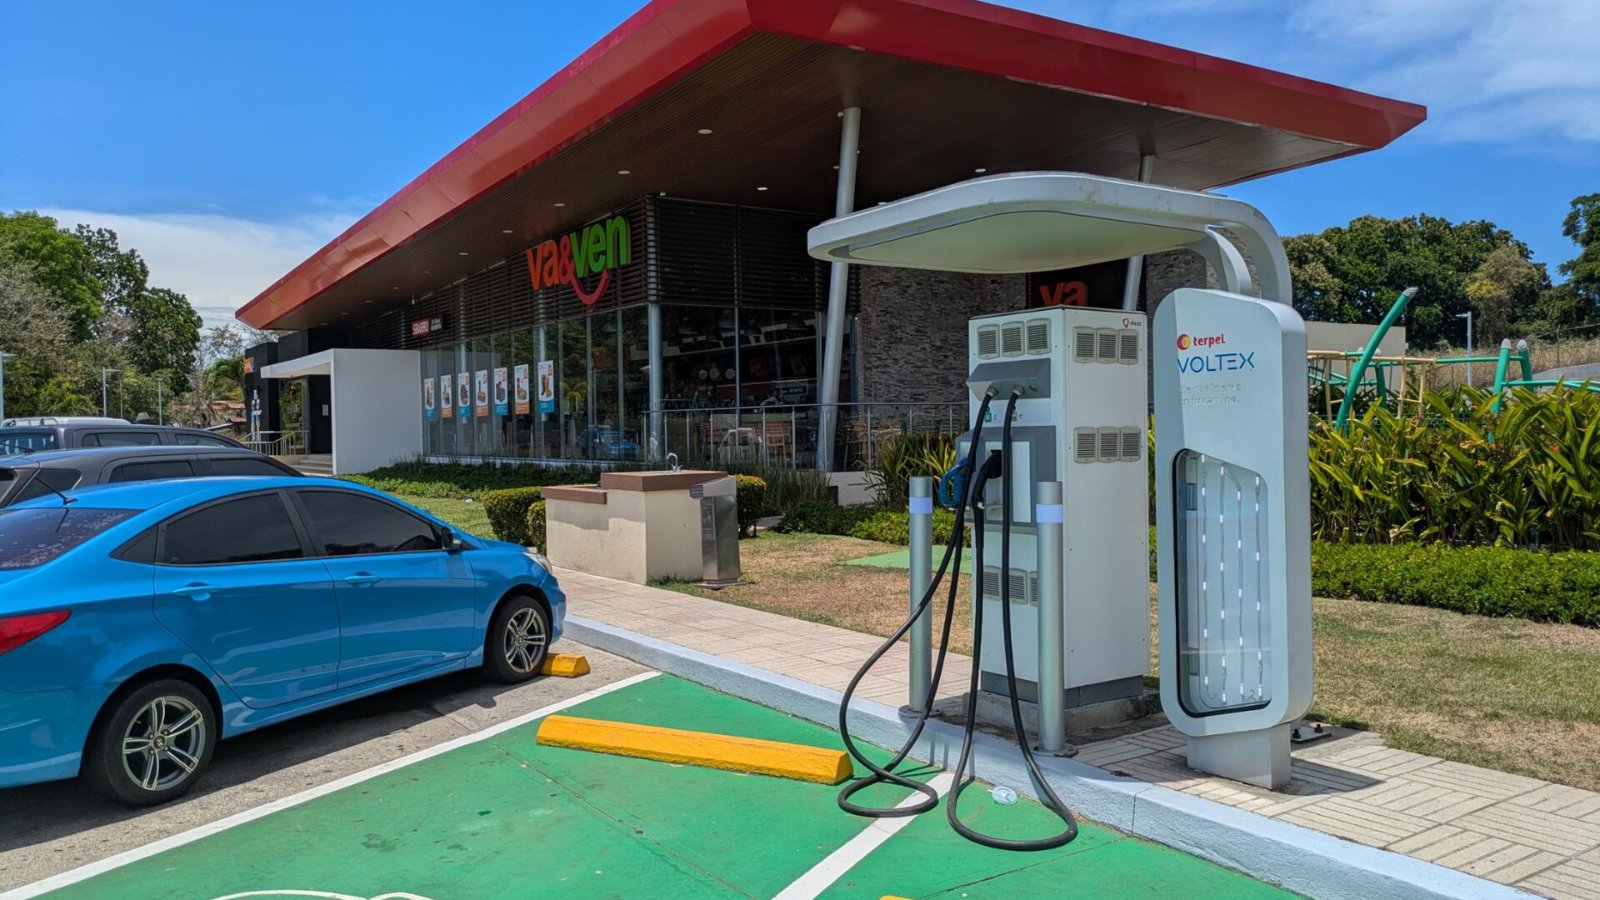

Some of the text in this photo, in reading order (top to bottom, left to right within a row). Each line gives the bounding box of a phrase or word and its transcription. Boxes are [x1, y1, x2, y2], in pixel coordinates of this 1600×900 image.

[527, 215, 631, 304] va&ven
[1039, 280, 1088, 306] va
[1193, 333, 1226, 348] terpel
[1177, 352, 1255, 374] VOLTEX
